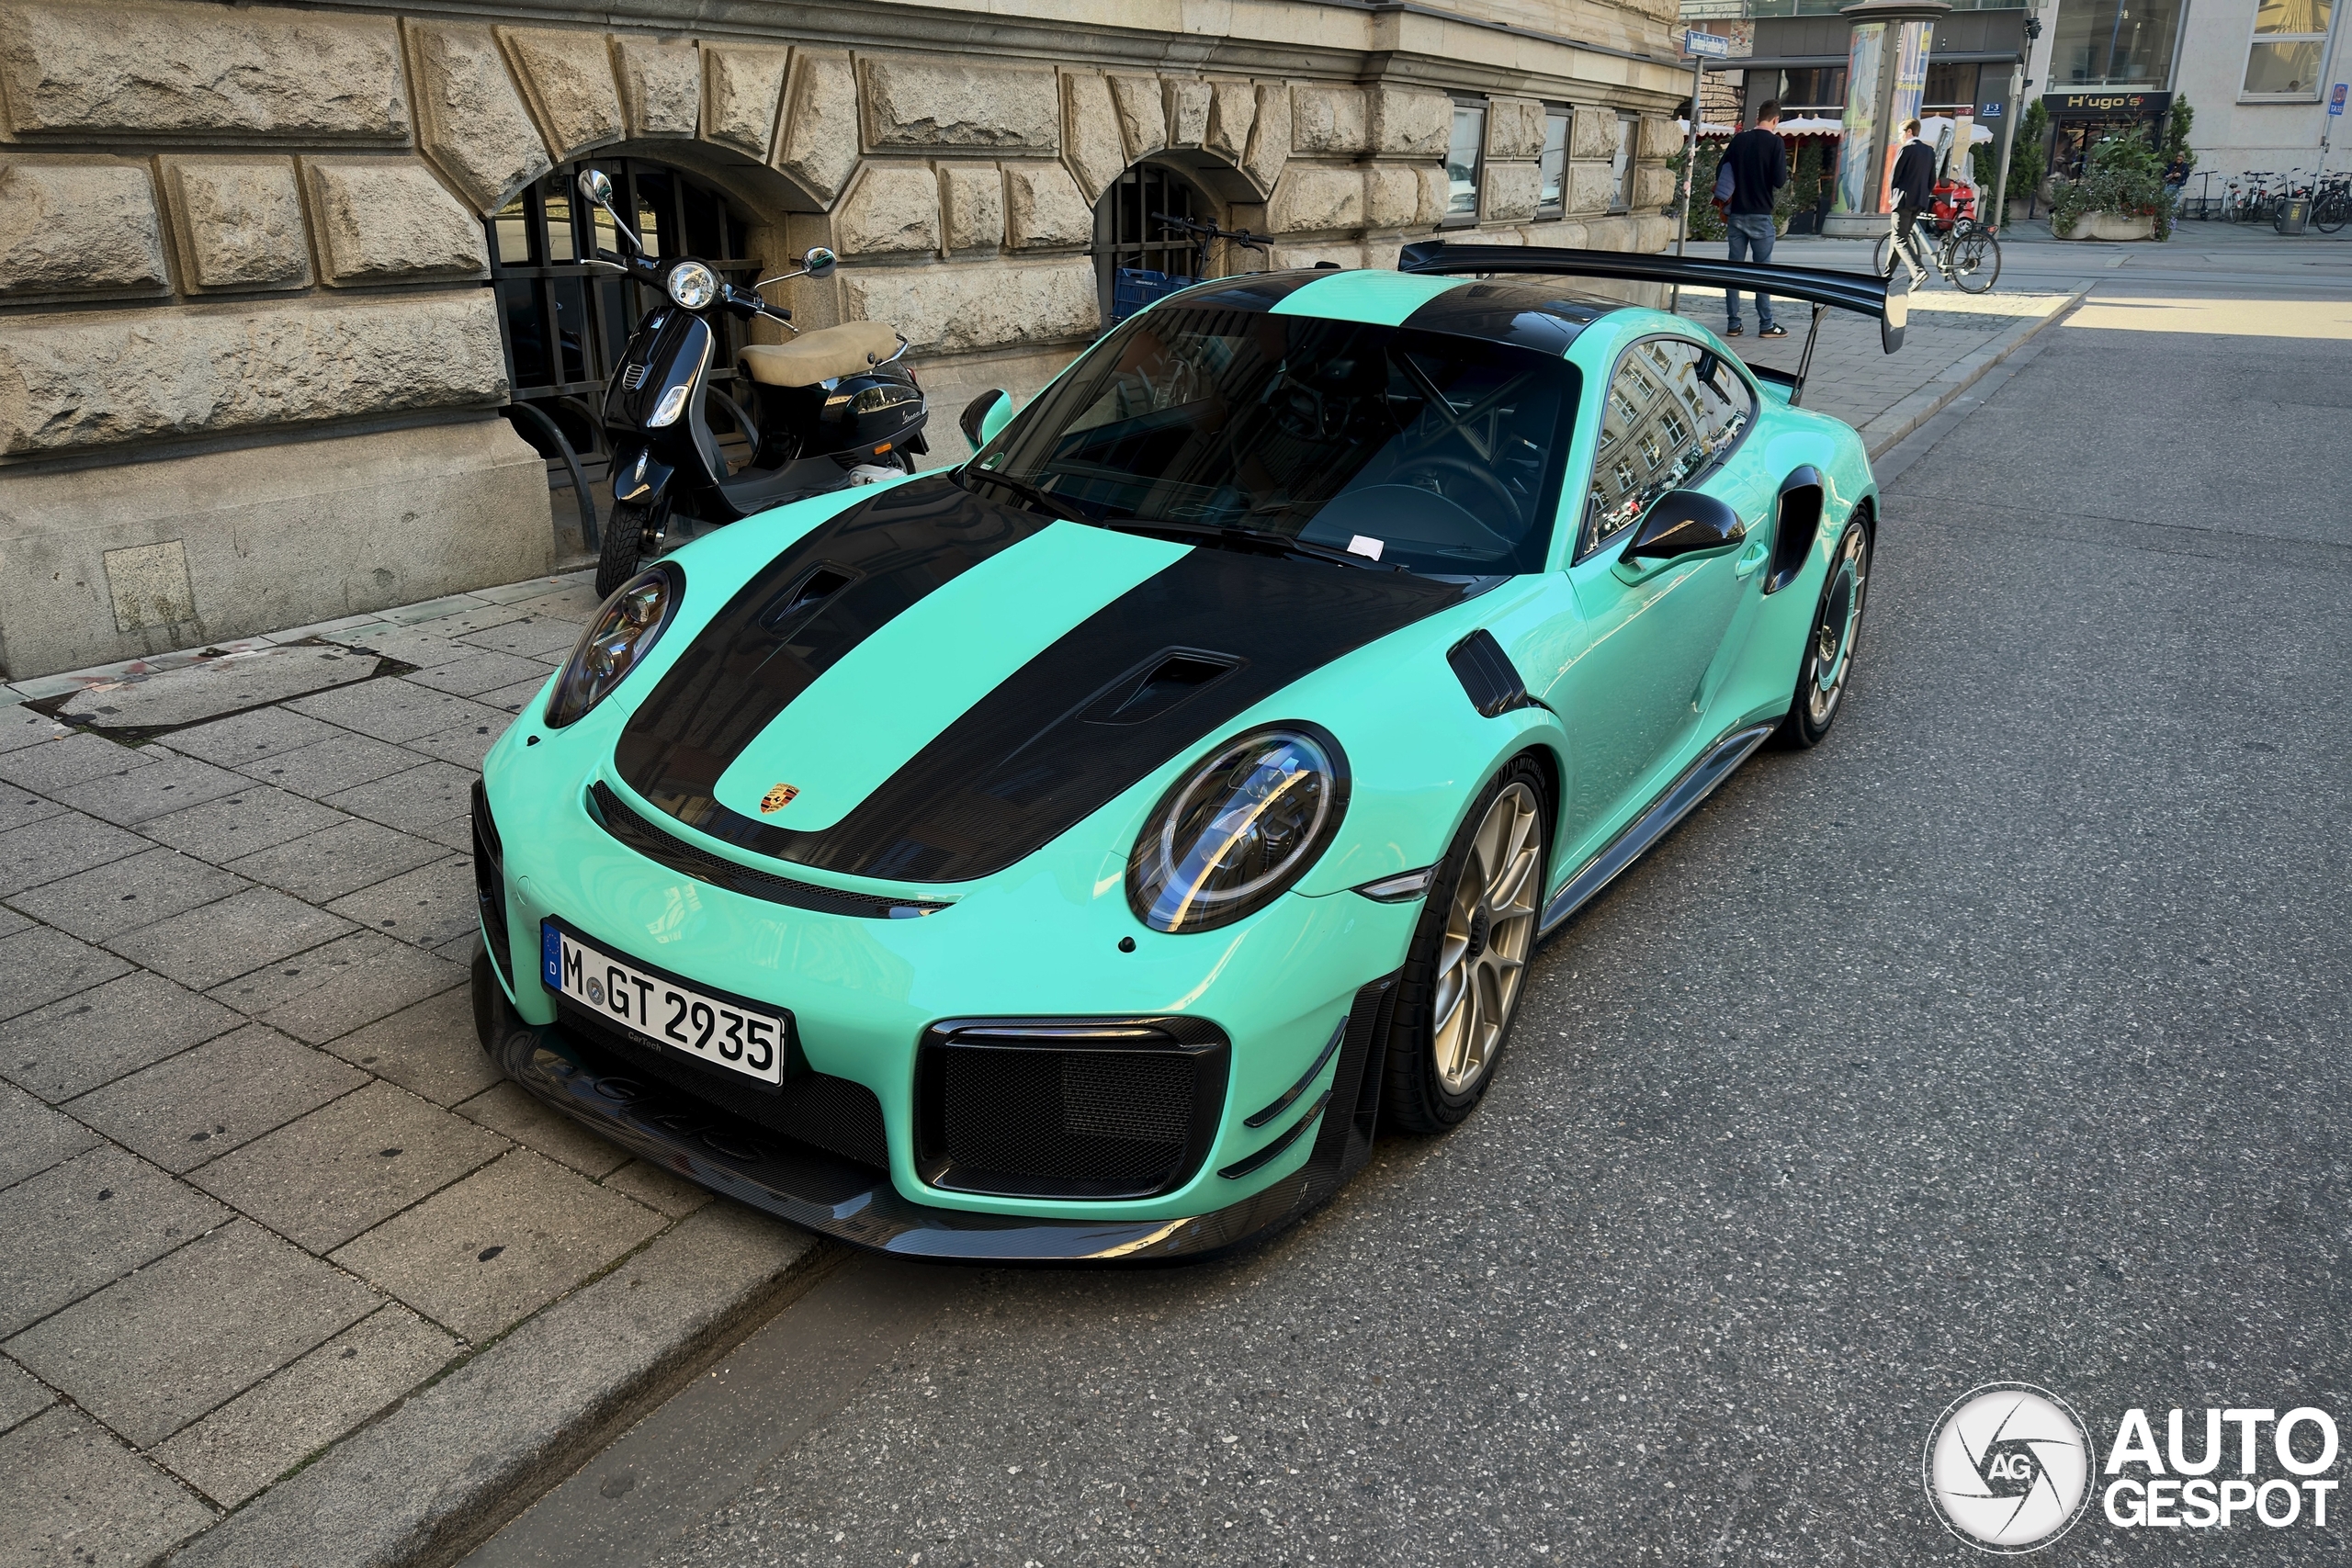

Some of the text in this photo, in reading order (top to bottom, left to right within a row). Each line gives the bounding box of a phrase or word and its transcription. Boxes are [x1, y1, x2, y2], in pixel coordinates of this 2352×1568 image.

[1518, 757, 1546, 789] MICHELIN
[549, 961, 557, 976] D
[562, 941, 774, 1071] M GT 2935
[628, 1031, 662, 1052] CarTech
